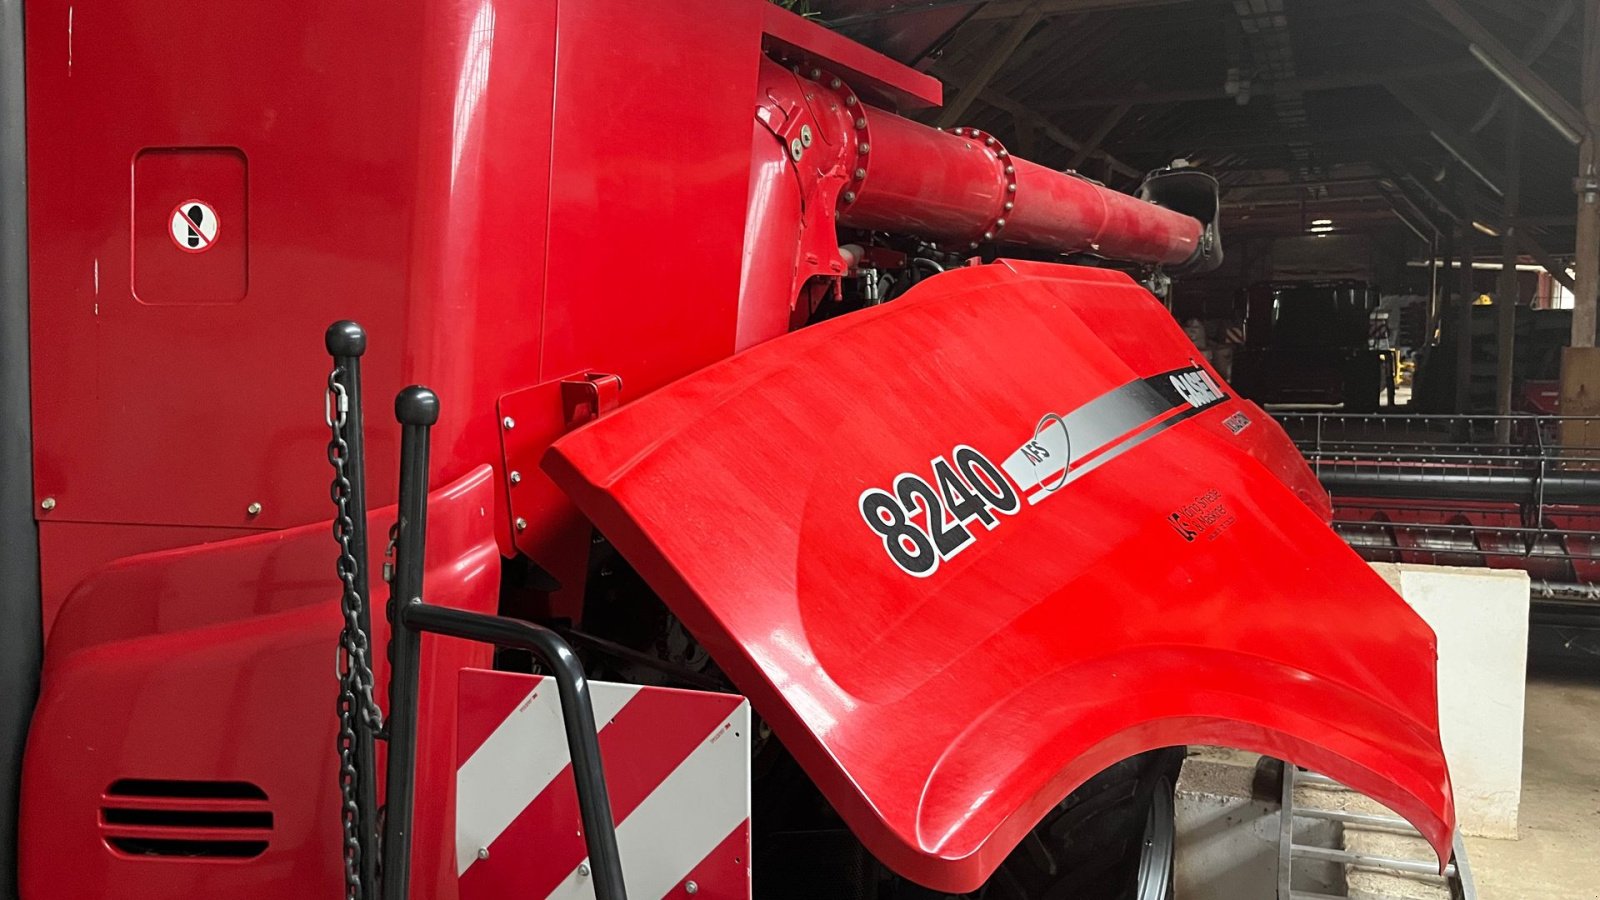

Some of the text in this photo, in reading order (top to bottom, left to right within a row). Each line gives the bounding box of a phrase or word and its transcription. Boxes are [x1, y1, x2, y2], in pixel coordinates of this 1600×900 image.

[1169, 371, 1217, 408] CASE
[1020, 440, 1051, 467] AFS
[859, 445, 1020, 577] 8240
